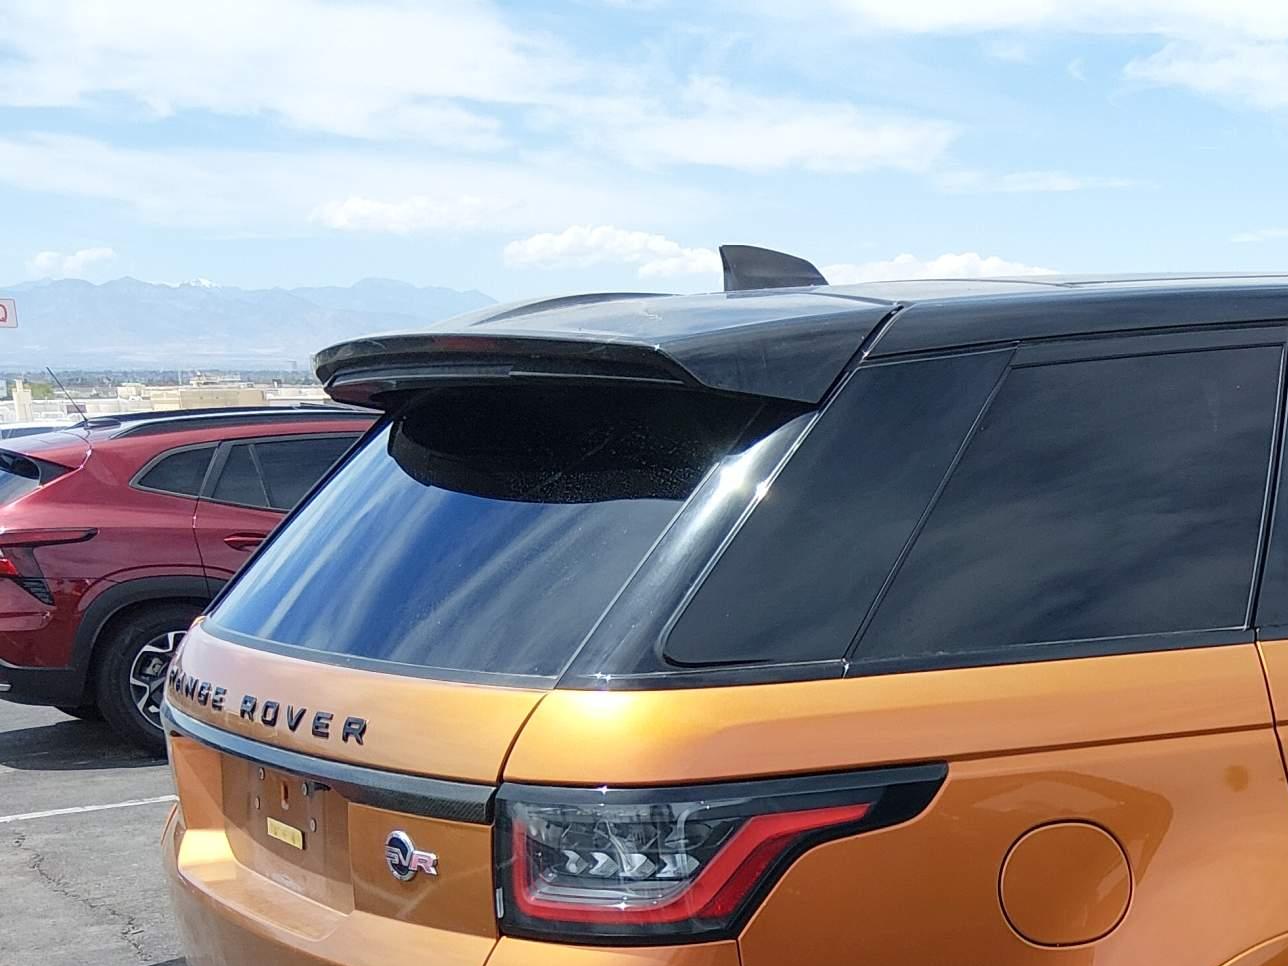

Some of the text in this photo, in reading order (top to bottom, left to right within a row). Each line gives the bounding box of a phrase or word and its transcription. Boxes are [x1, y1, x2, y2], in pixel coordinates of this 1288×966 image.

[168, 668, 369, 746] RANGE ROVER
[385, 844, 439, 876] SVR
